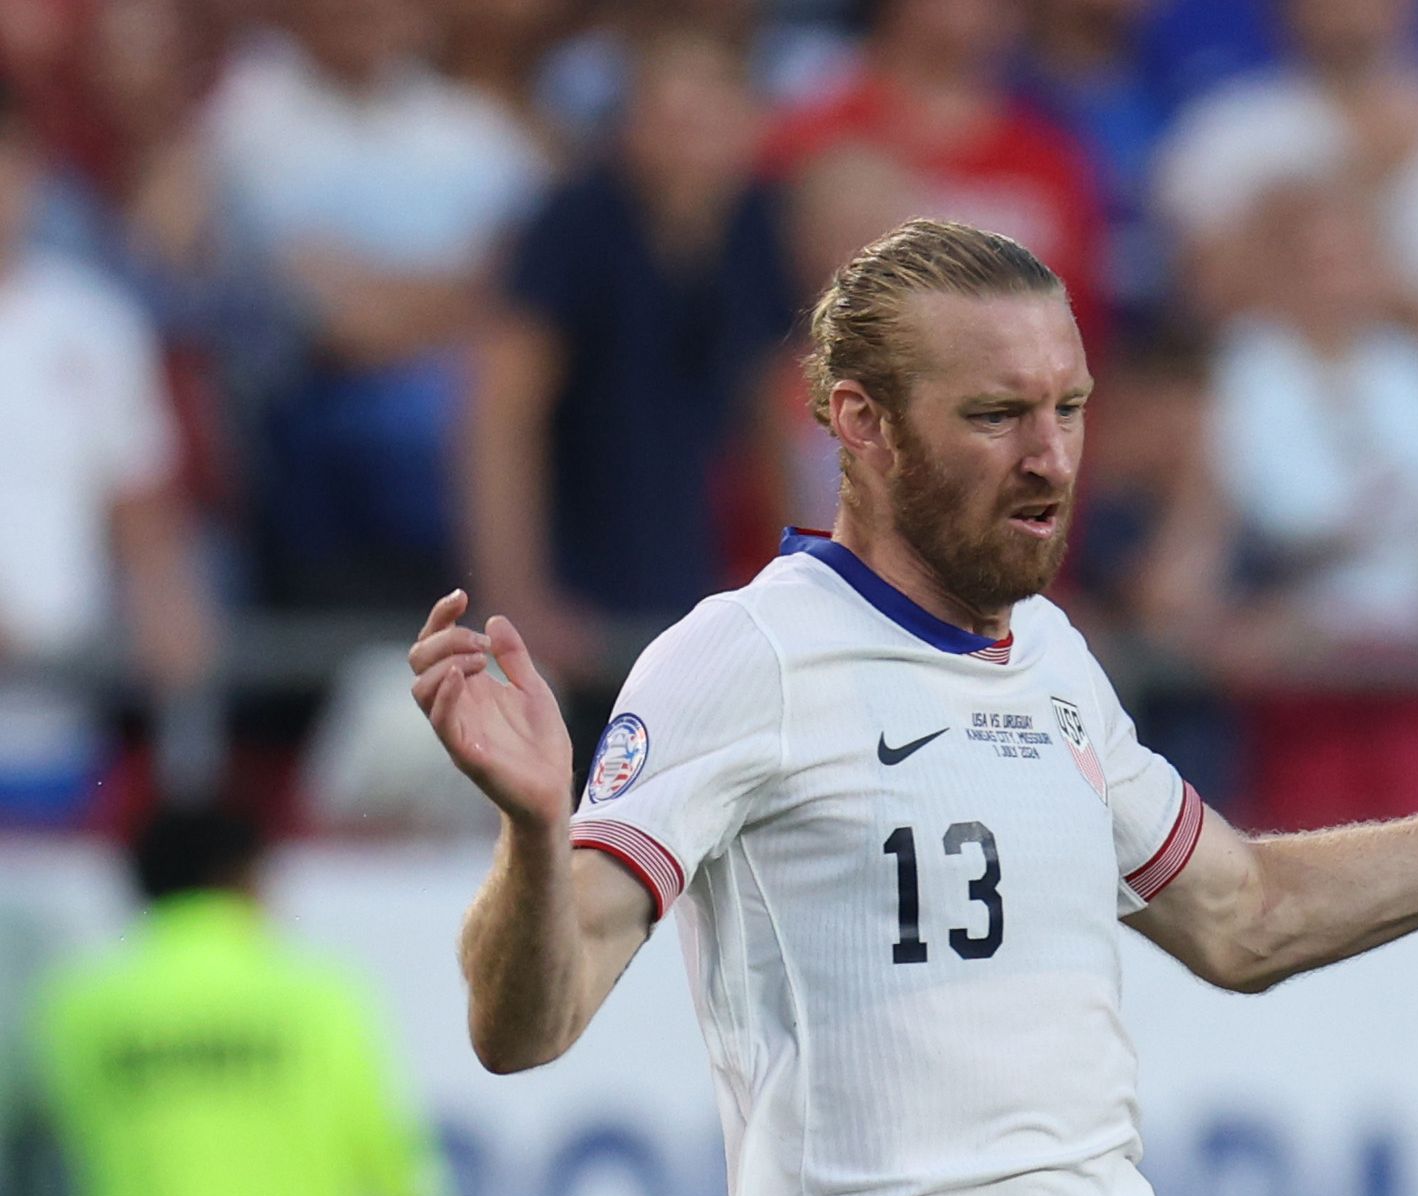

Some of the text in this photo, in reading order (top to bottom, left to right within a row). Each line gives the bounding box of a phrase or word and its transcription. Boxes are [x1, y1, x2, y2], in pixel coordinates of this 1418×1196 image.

[972, 713, 987, 728] USA
[1003, 714, 1033, 730] URUGUAY
[1054, 704, 1085, 746] USA
[965, 728, 997, 742] KANSAS
[1017, 732, 1053, 745] MISSOURI
[883, 821, 1004, 964] 13
